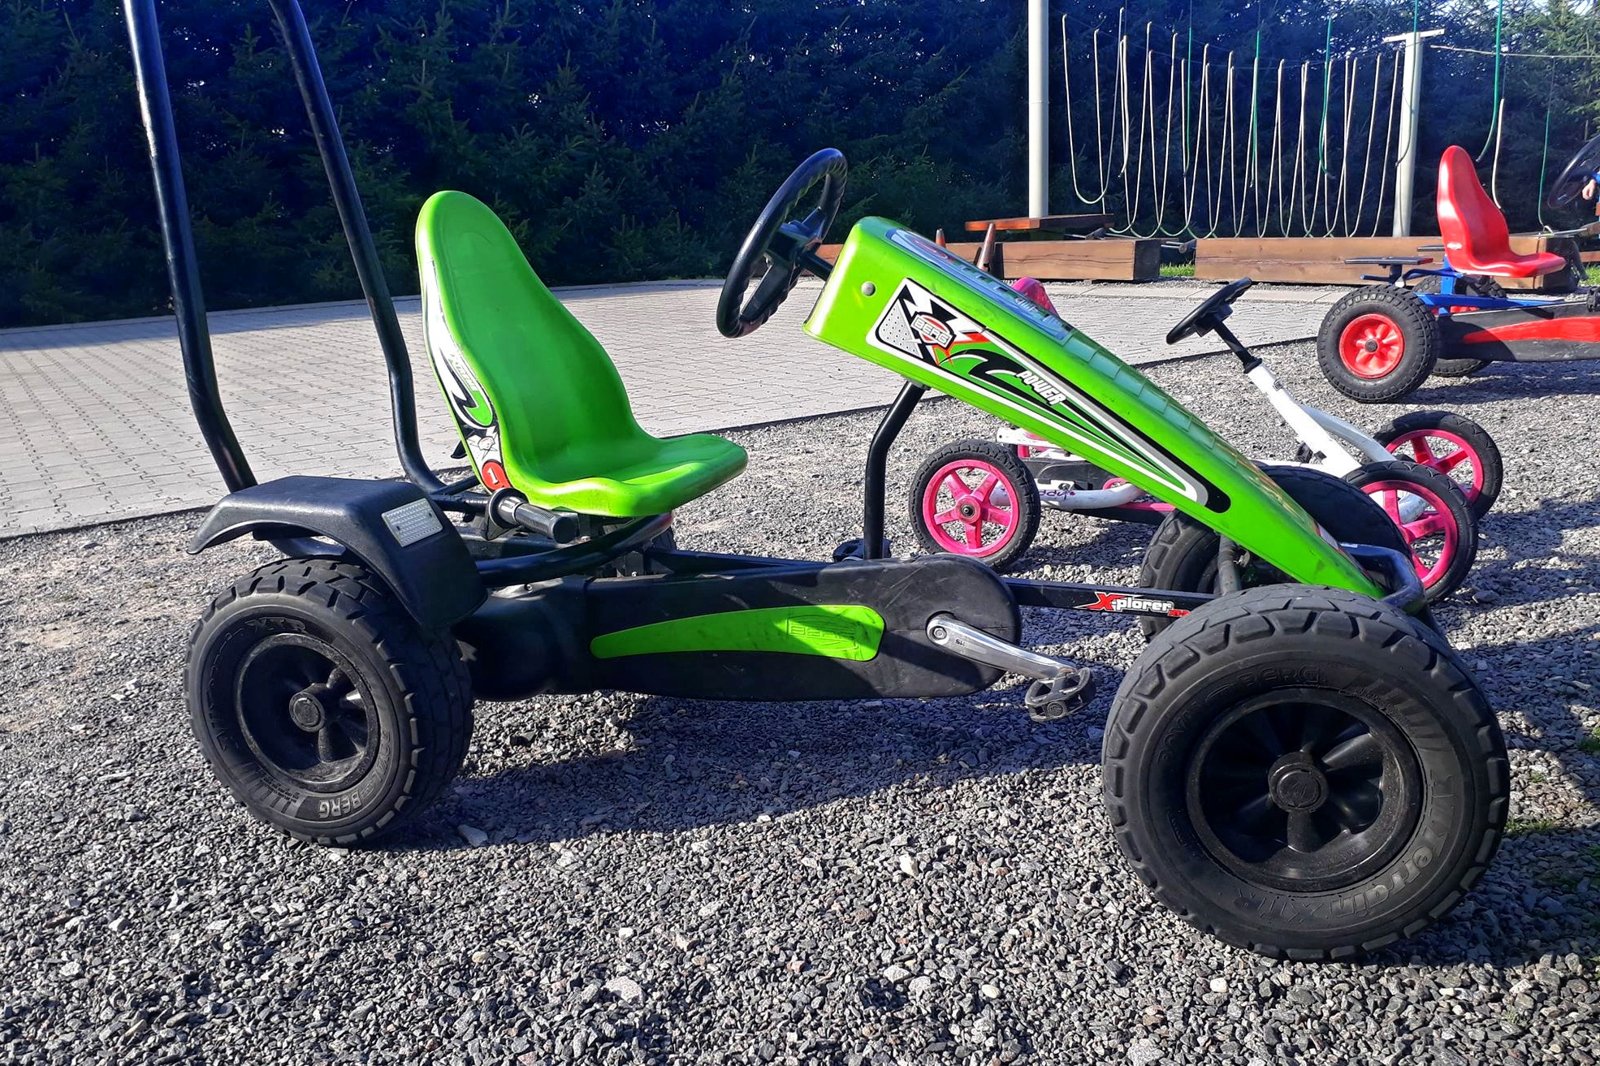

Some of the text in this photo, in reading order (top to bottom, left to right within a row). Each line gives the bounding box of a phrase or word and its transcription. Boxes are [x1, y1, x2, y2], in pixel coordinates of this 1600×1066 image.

[911, 315, 953, 347] BERG
[1015, 370, 1067, 405] POWER
[1237, 663, 1320, 687] BERG
[317, 790, 362, 819] BERG
[1330, 825, 1449, 919] Terrain
